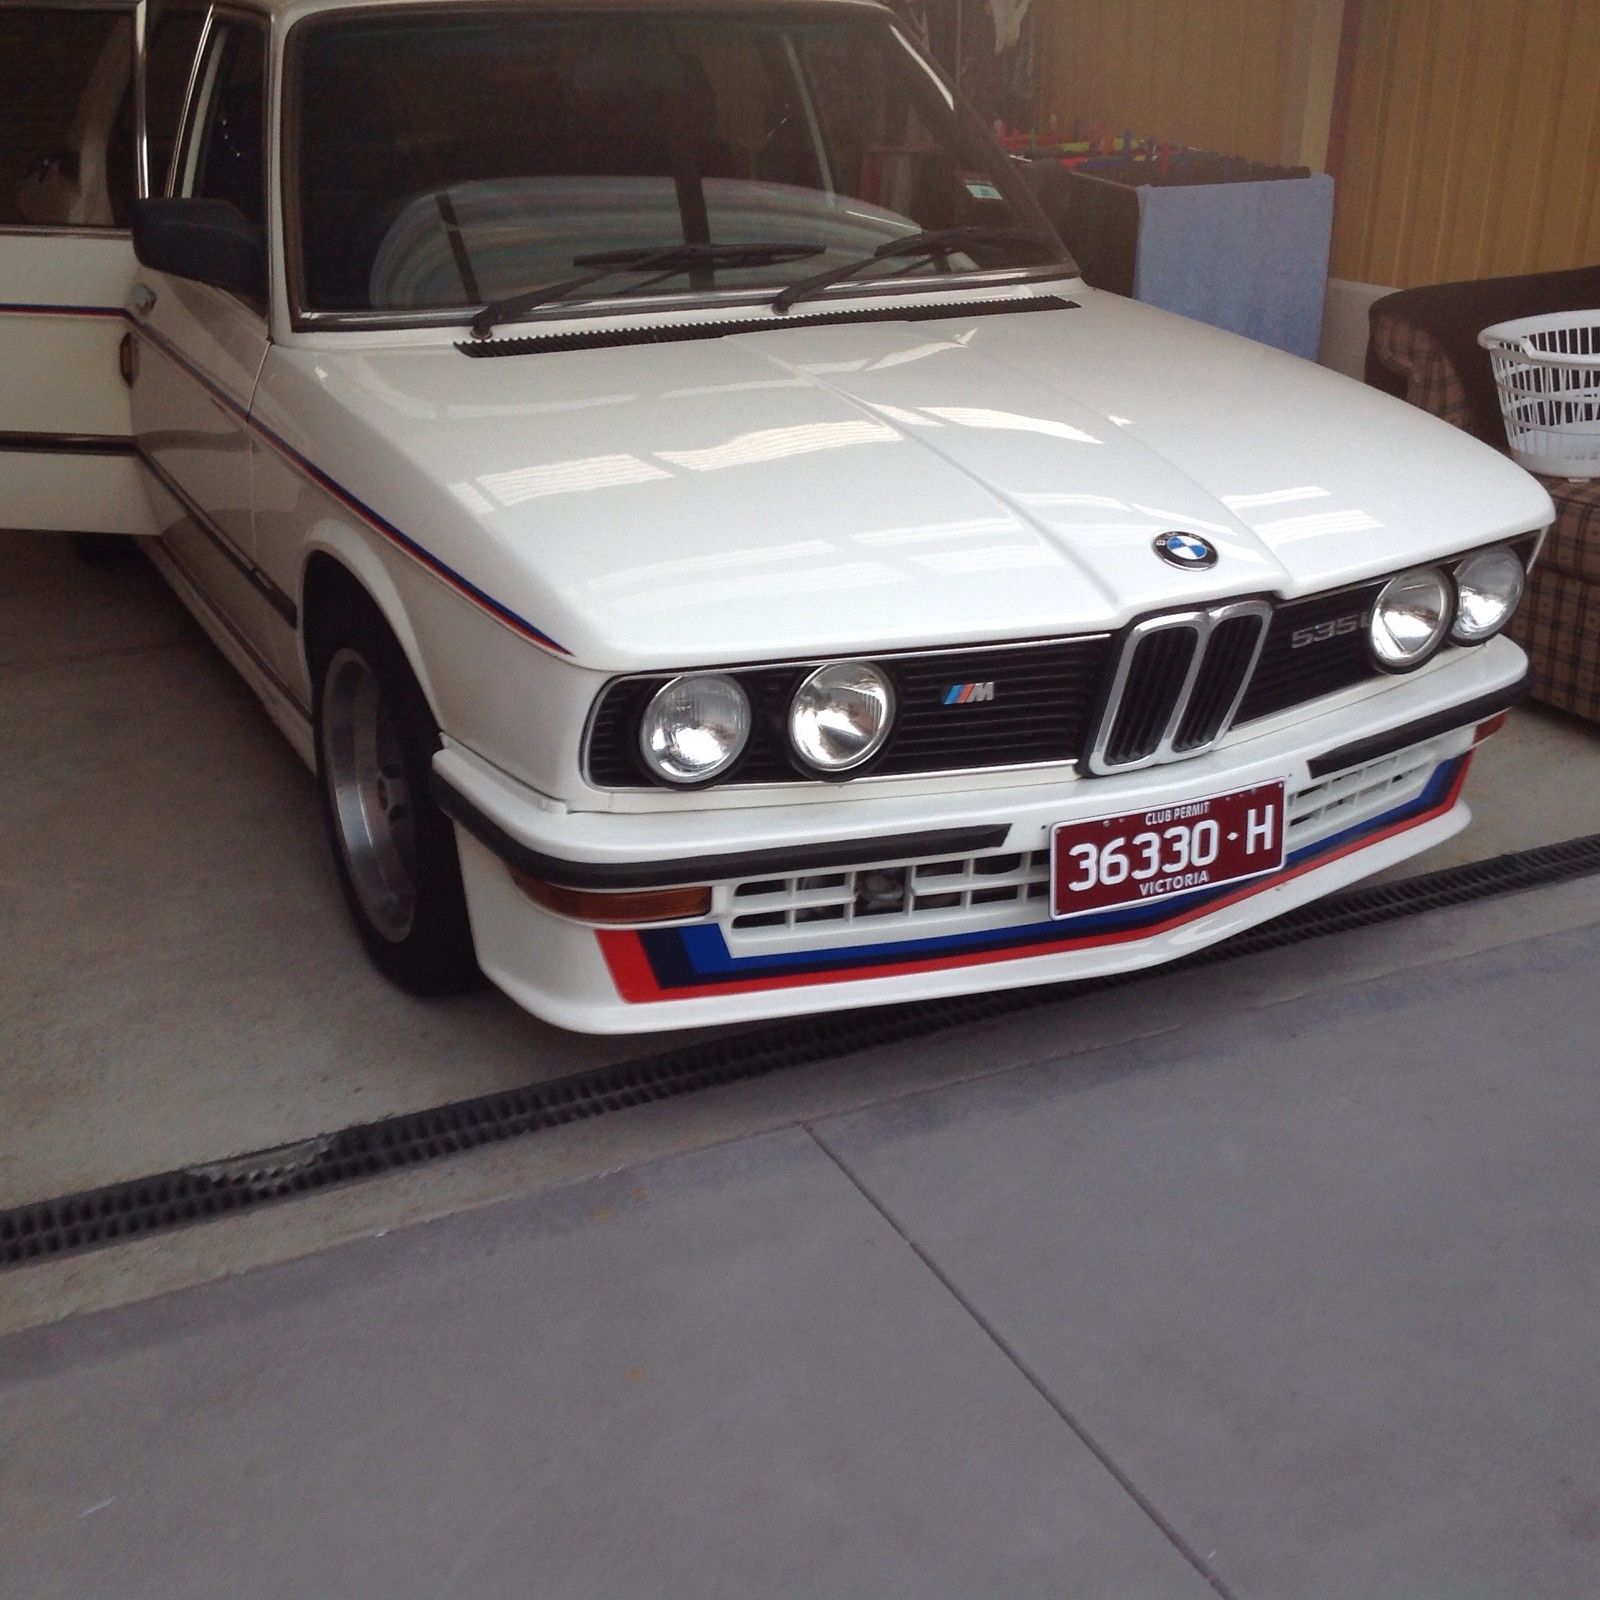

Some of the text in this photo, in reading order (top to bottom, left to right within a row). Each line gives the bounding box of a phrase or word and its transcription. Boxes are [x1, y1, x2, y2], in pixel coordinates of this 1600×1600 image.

[1145, 801, 1211, 826] CLUB PERMIT
[1139, 870, 1210, 897] VICTORIA
